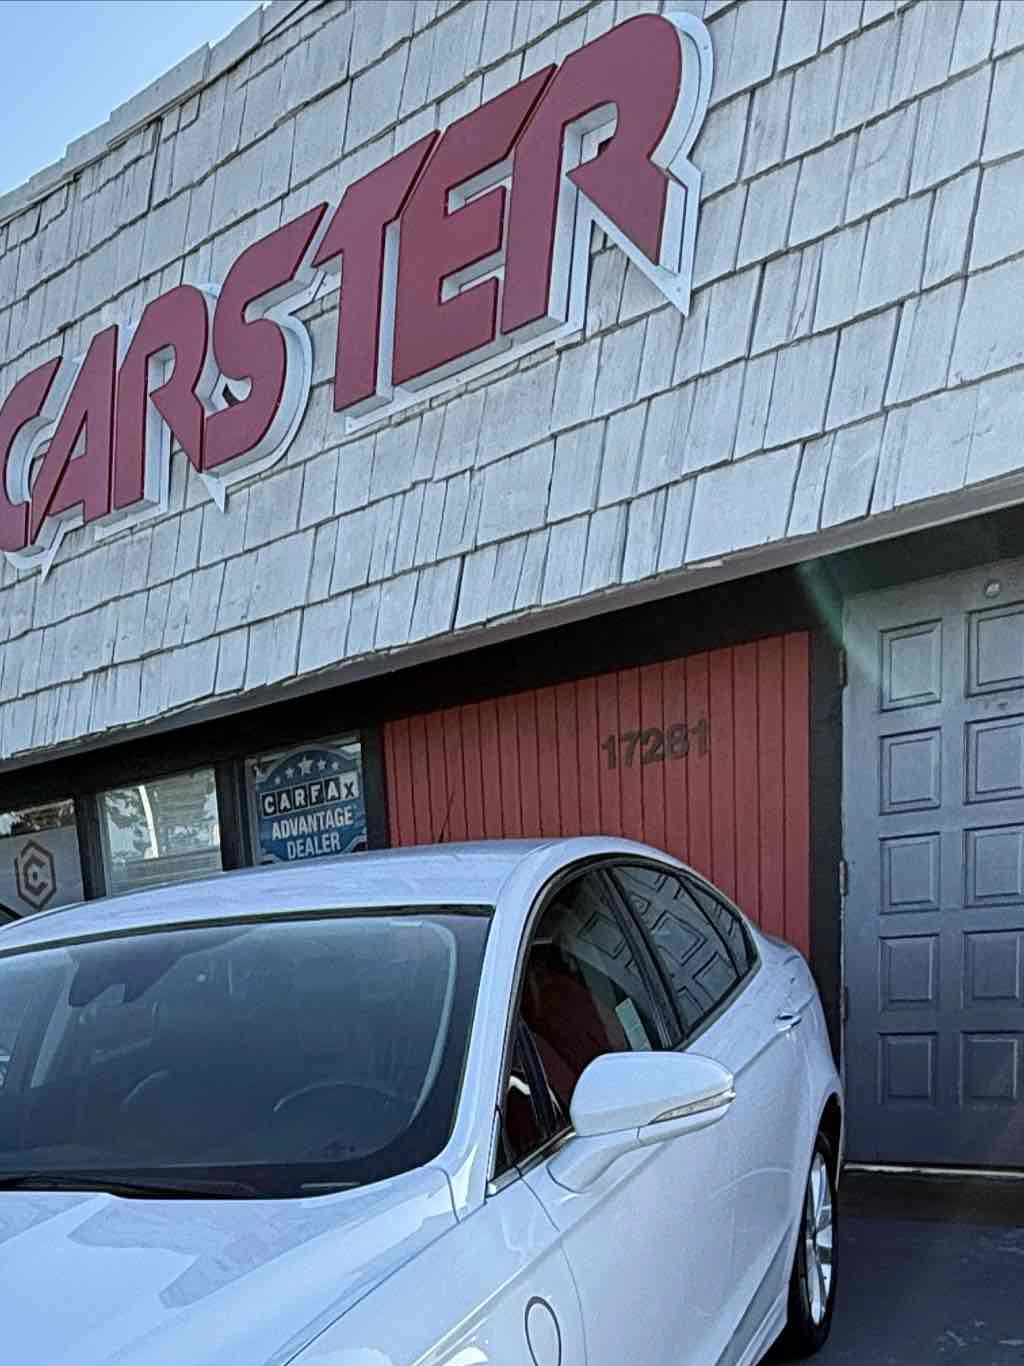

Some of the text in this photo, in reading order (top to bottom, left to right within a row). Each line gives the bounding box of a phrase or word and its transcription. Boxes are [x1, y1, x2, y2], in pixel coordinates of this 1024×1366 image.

[601, 718, 710, 769] 17281
[262, 779, 360, 815] CARFAX
[272, 805, 355, 841] ADVANTAGE
[286, 832, 342, 861] DEALER
